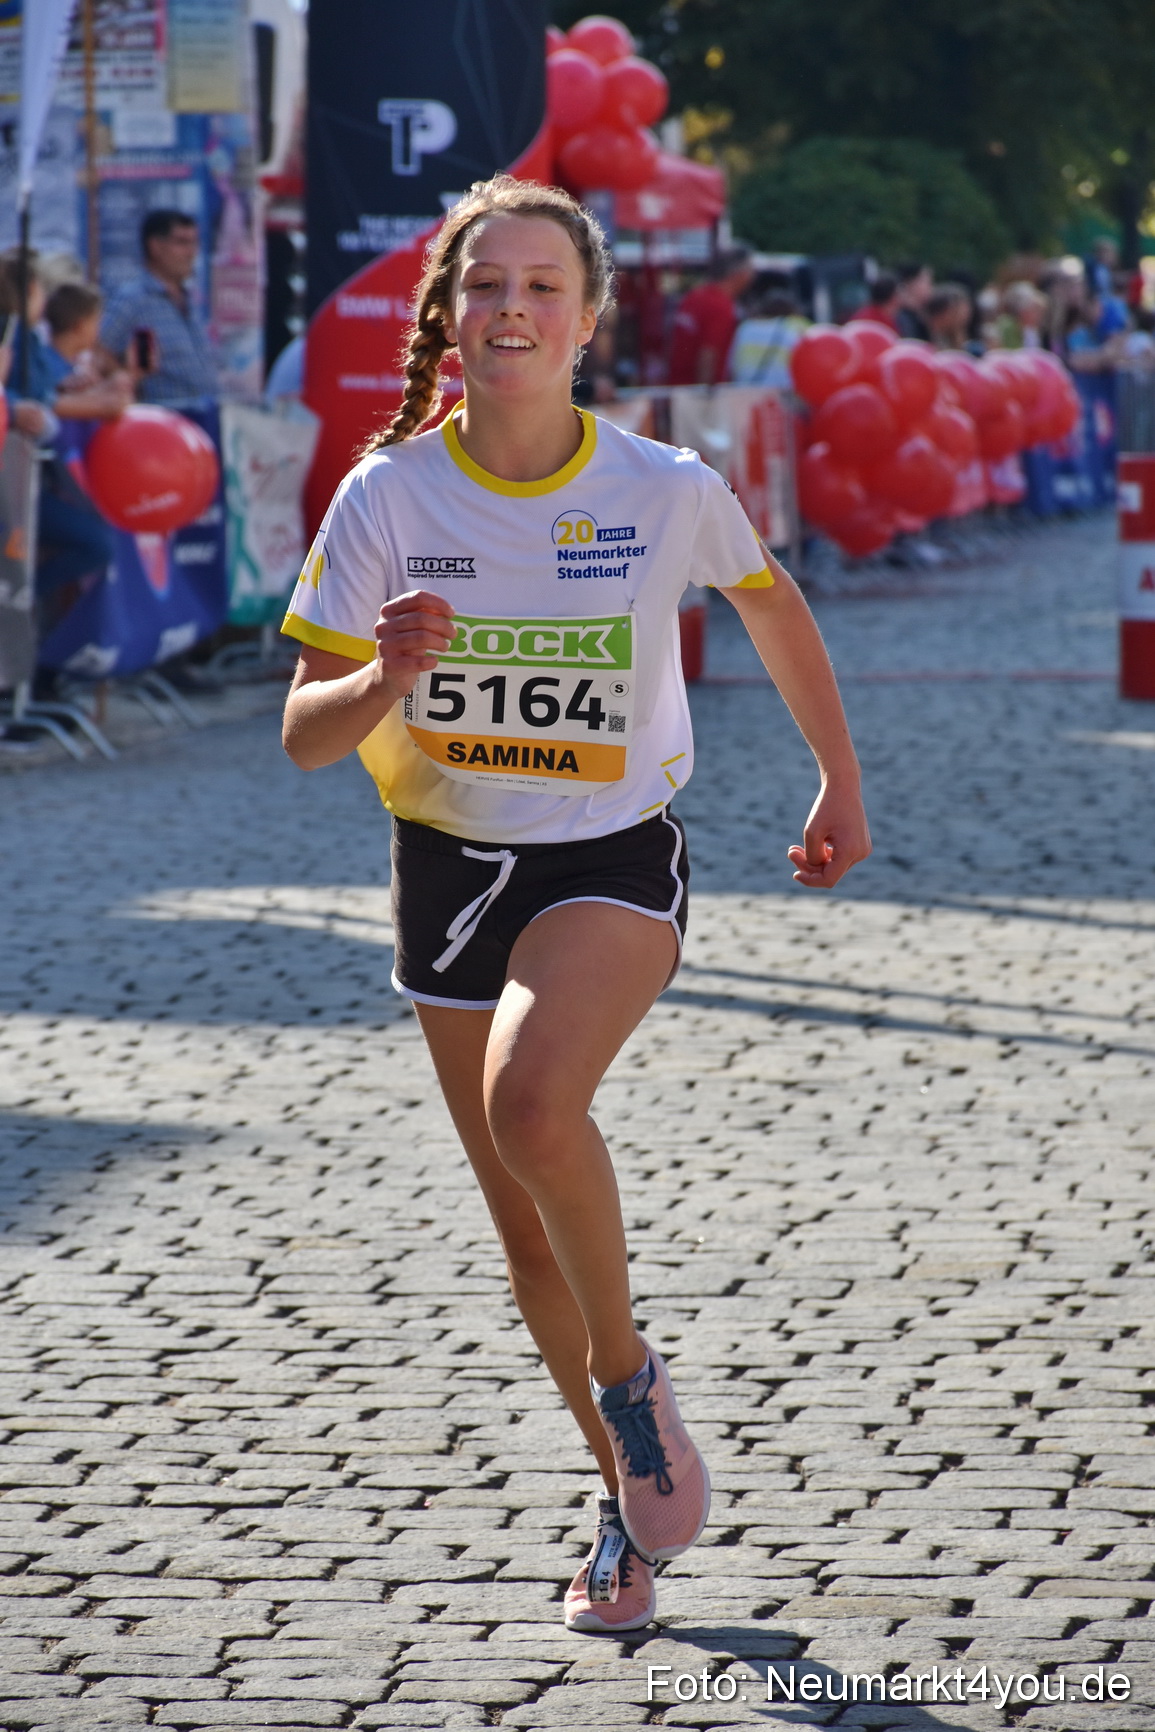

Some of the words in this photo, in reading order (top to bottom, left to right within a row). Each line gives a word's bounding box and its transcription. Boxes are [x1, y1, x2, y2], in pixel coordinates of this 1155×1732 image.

[557, 520, 594, 545] 20
[600, 528, 633, 541] JAHRE
[557, 545, 647, 561] Neumarkter
[407, 557, 476, 573] BOCK
[557, 563, 630, 579] Stadtlauf
[614, 684, 624, 694] S
[427, 672, 606, 731] 5164
[446, 742, 579, 773] SAMINA
[599, 1571, 611, 1602] 5164
